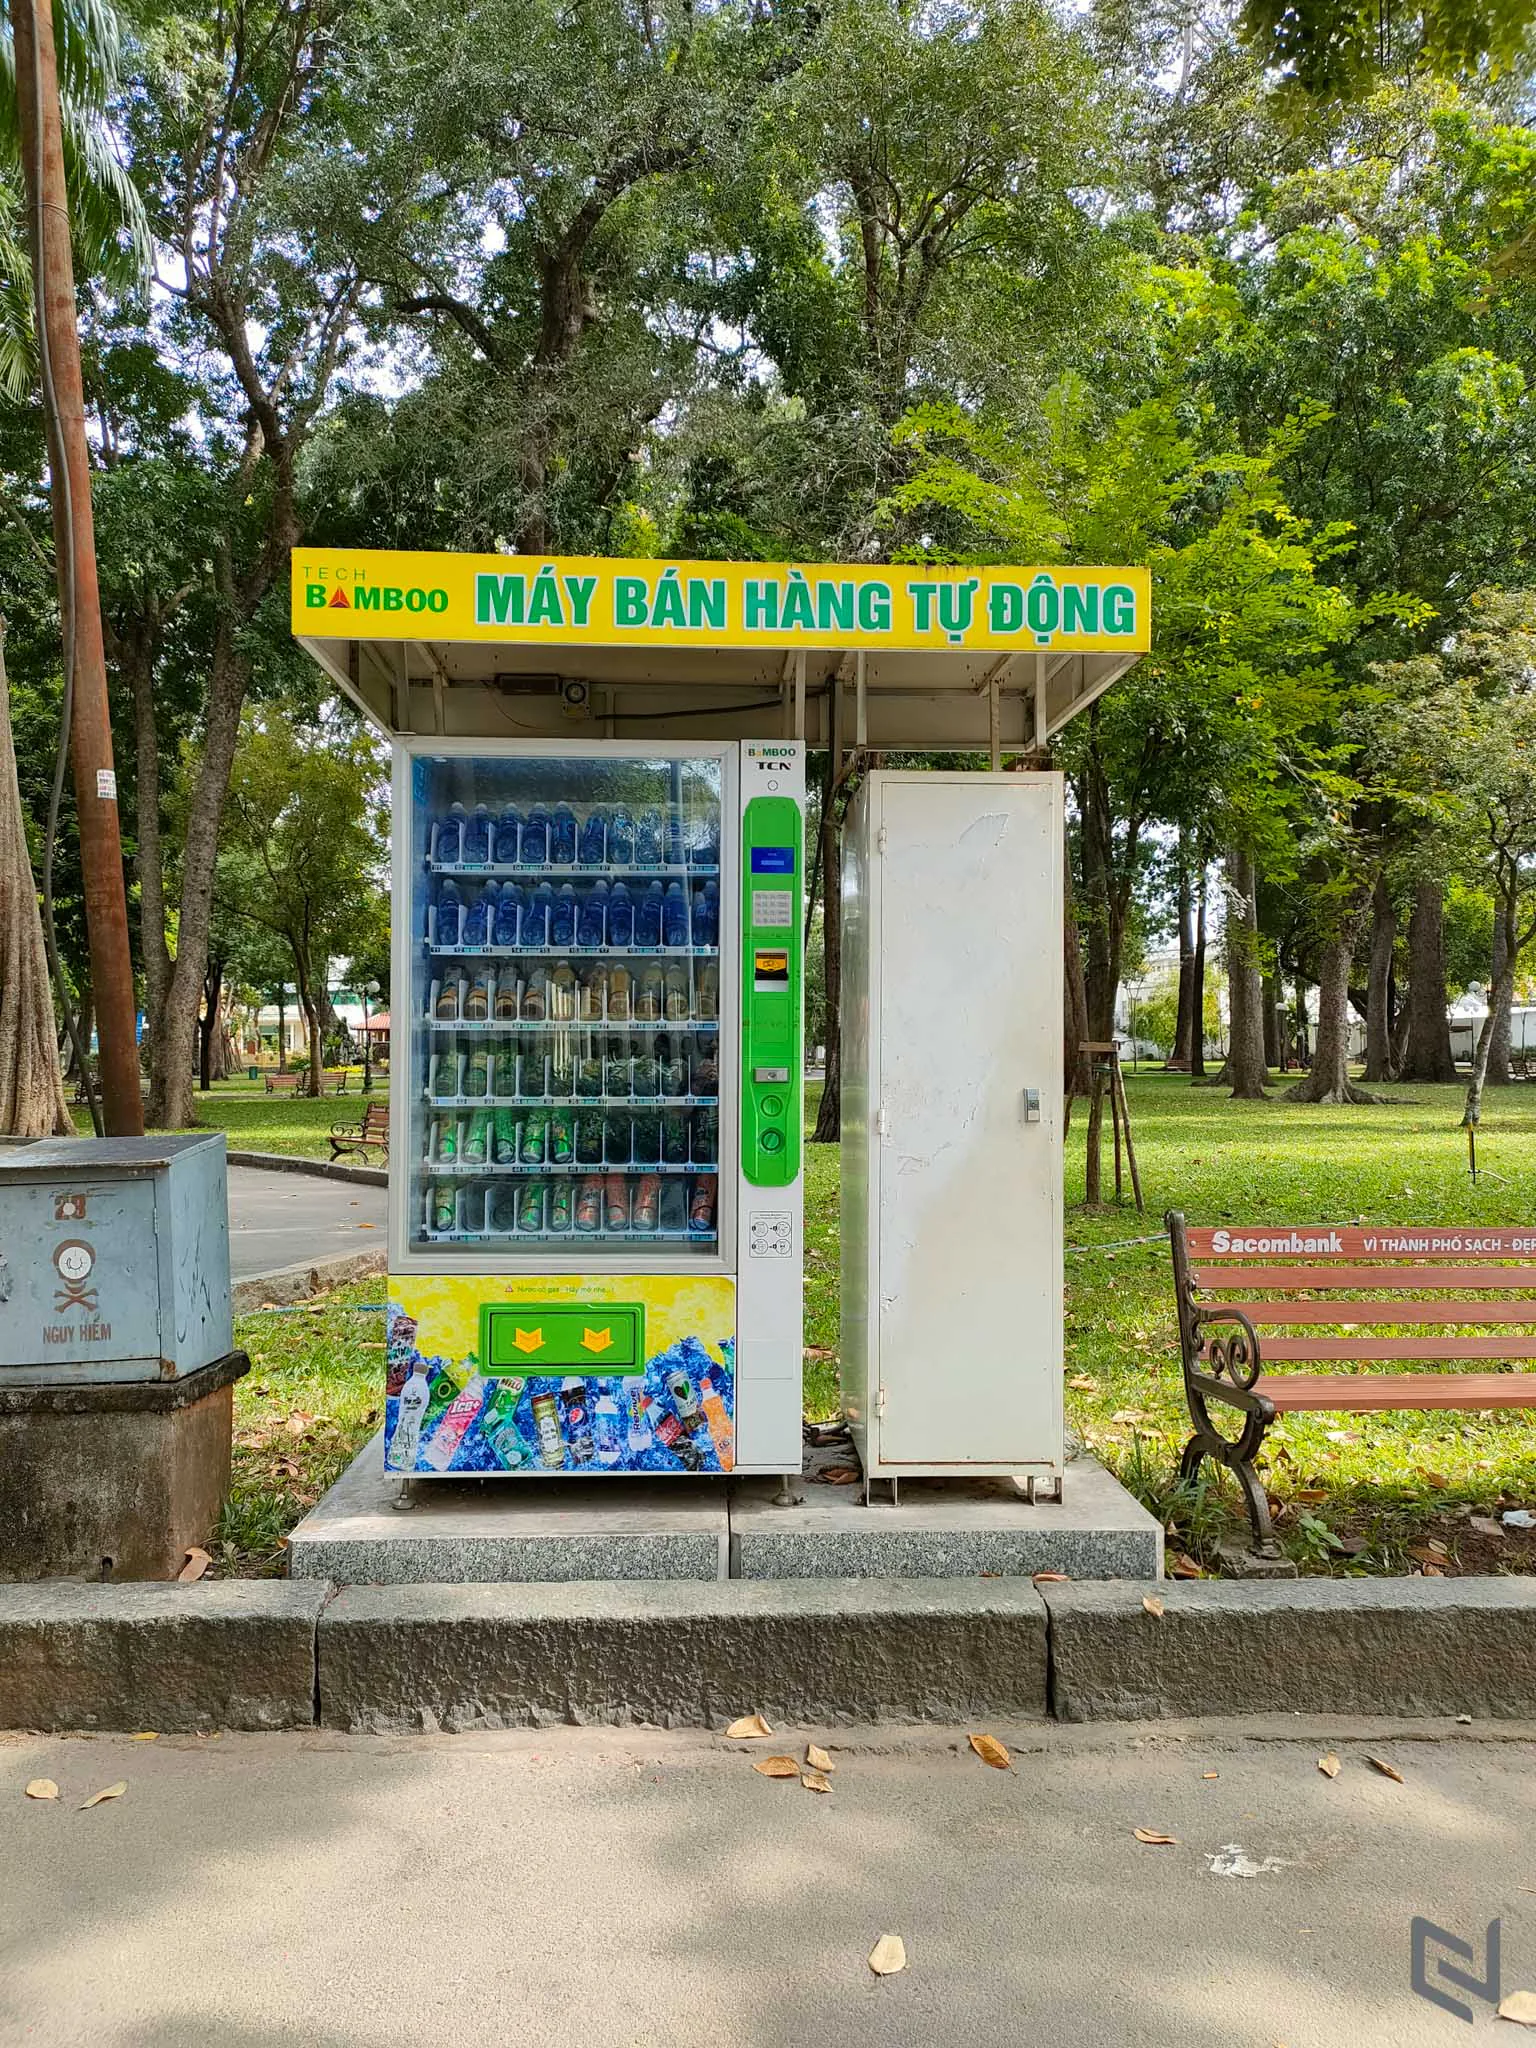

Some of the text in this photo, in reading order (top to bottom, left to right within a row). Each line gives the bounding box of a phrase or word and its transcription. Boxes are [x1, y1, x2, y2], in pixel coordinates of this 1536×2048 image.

[303, 566, 366, 581] TECH
[475, 565, 1135, 643] MÁY BÁN HÀNG TỰ ĐỘNG
[756, 761, 791, 770] TCN
[1212, 1231, 1343, 1253] Sacombank
[1363, 1236, 1377, 1251] VÌ
[1380, 1236, 1429, 1251] THÀNH
[1432, 1234, 1462, 1251] PHỐ
[1465, 1239, 1501, 1255] SẠCH
[42, 1325, 75, 1345] NGUY
